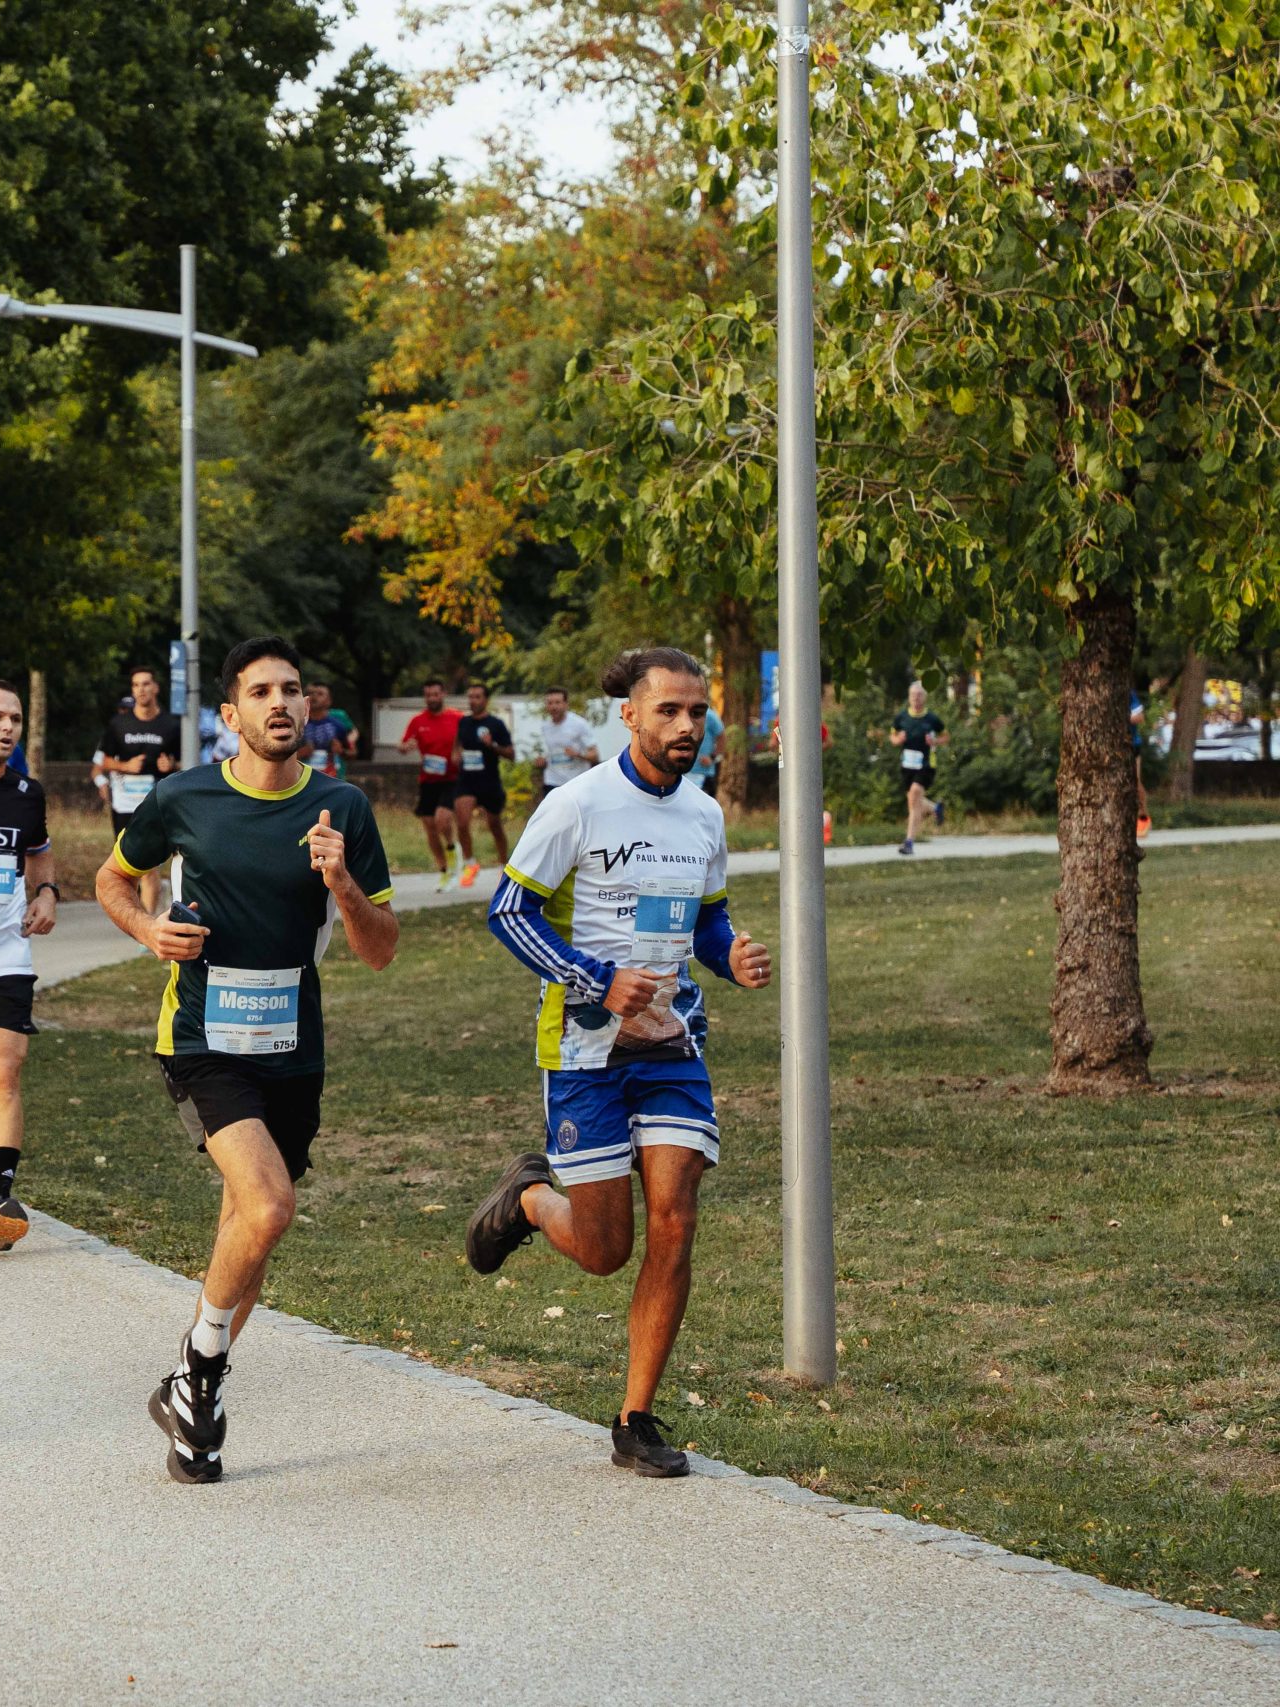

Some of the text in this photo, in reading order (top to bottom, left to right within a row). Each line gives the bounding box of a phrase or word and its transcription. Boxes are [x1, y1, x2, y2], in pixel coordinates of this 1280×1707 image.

[636, 854, 658, 863] PAUL
[661, 854, 697, 864] WAGNER
[670, 901, 686, 922] Hj
[218, 990, 289, 1010] Messon
[246, 1014, 263, 1022] 6754
[273, 1040, 296, 1050] 6754
